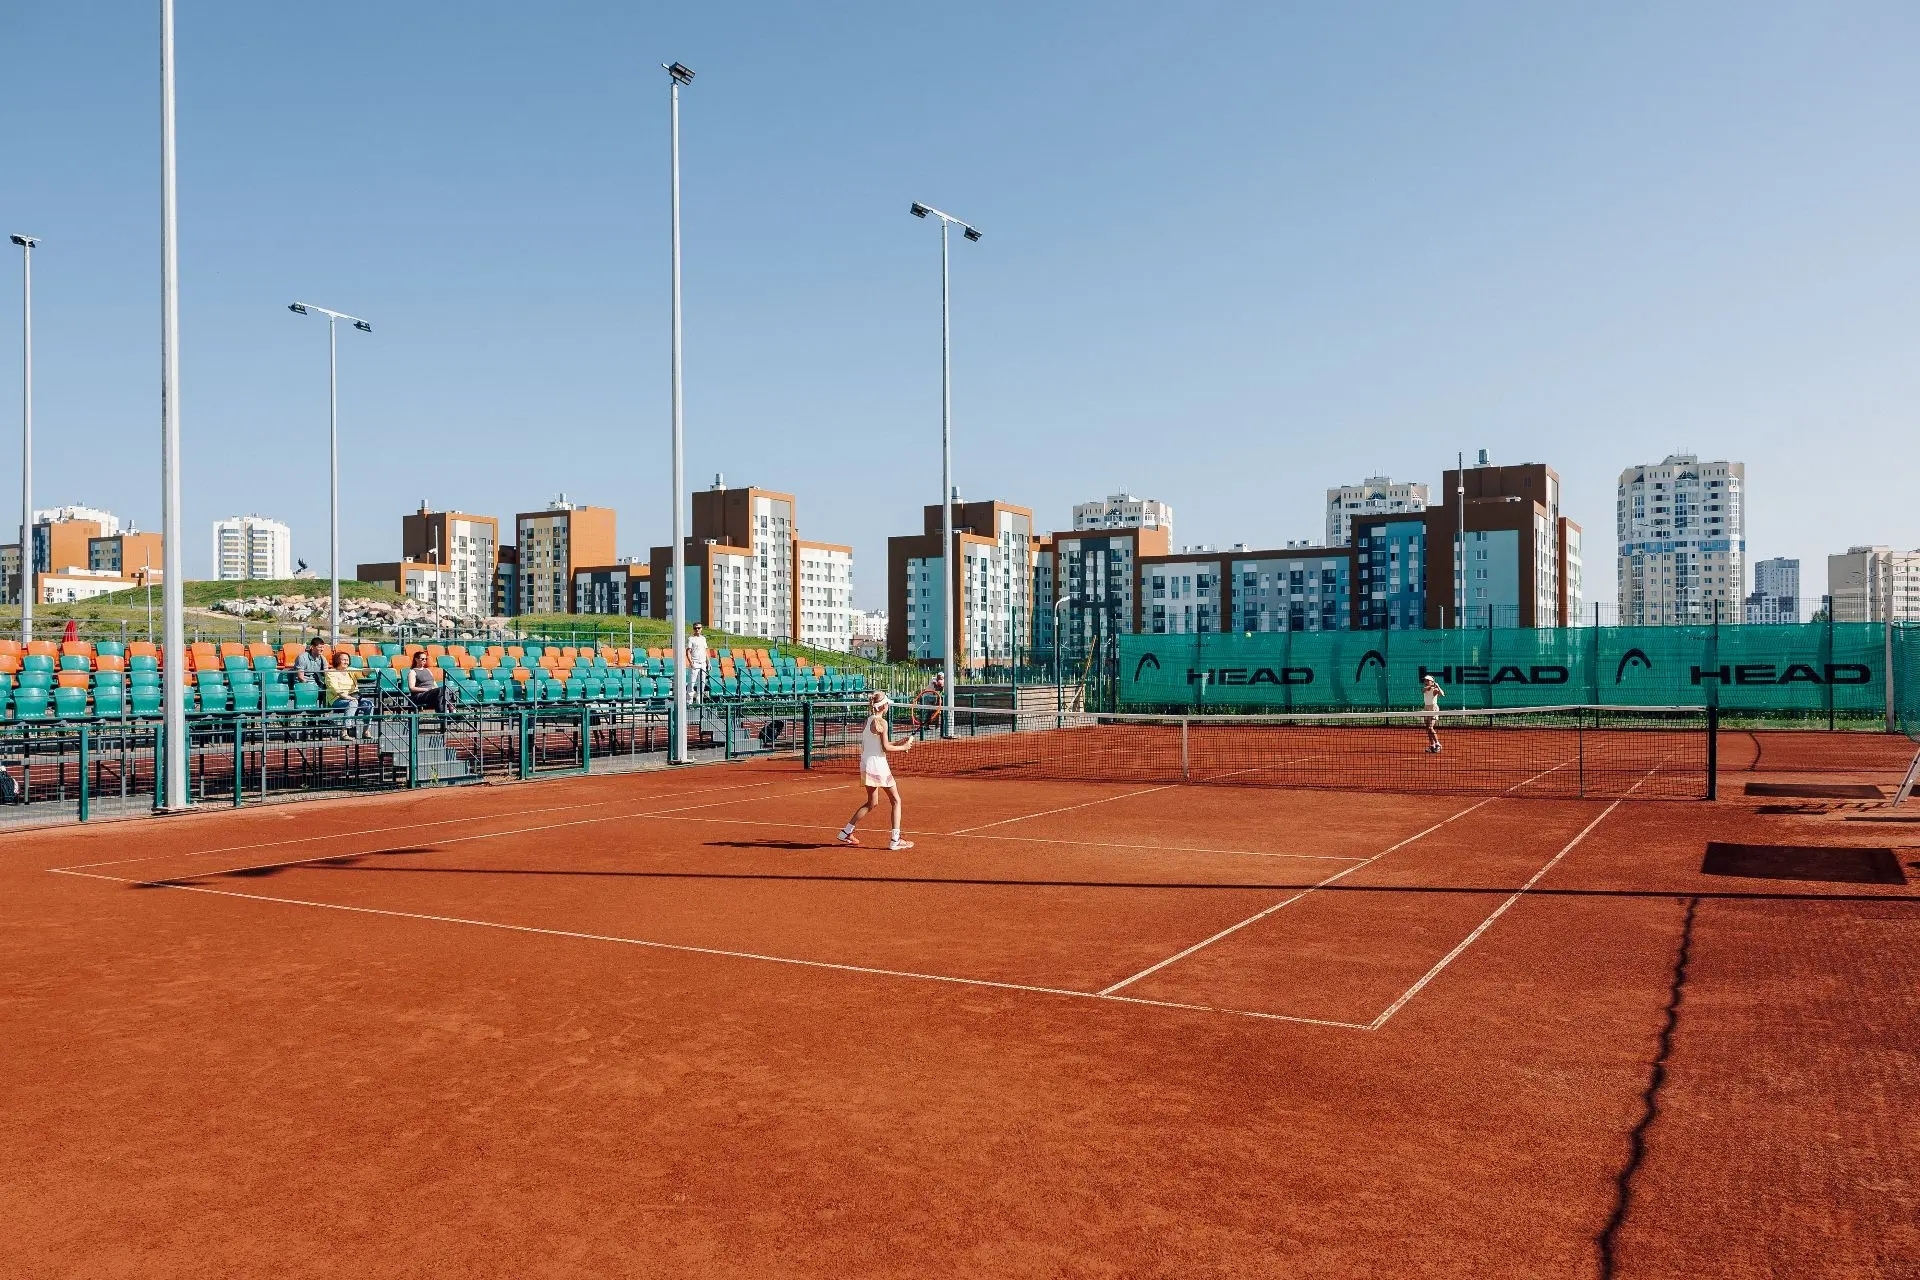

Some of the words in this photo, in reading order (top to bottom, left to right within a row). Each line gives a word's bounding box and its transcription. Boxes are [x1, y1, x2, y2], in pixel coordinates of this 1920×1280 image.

[1187, 667, 1314, 685] HEAD
[1418, 666, 1569, 684] HEAD
[1690, 664, 1871, 685] HEAD
